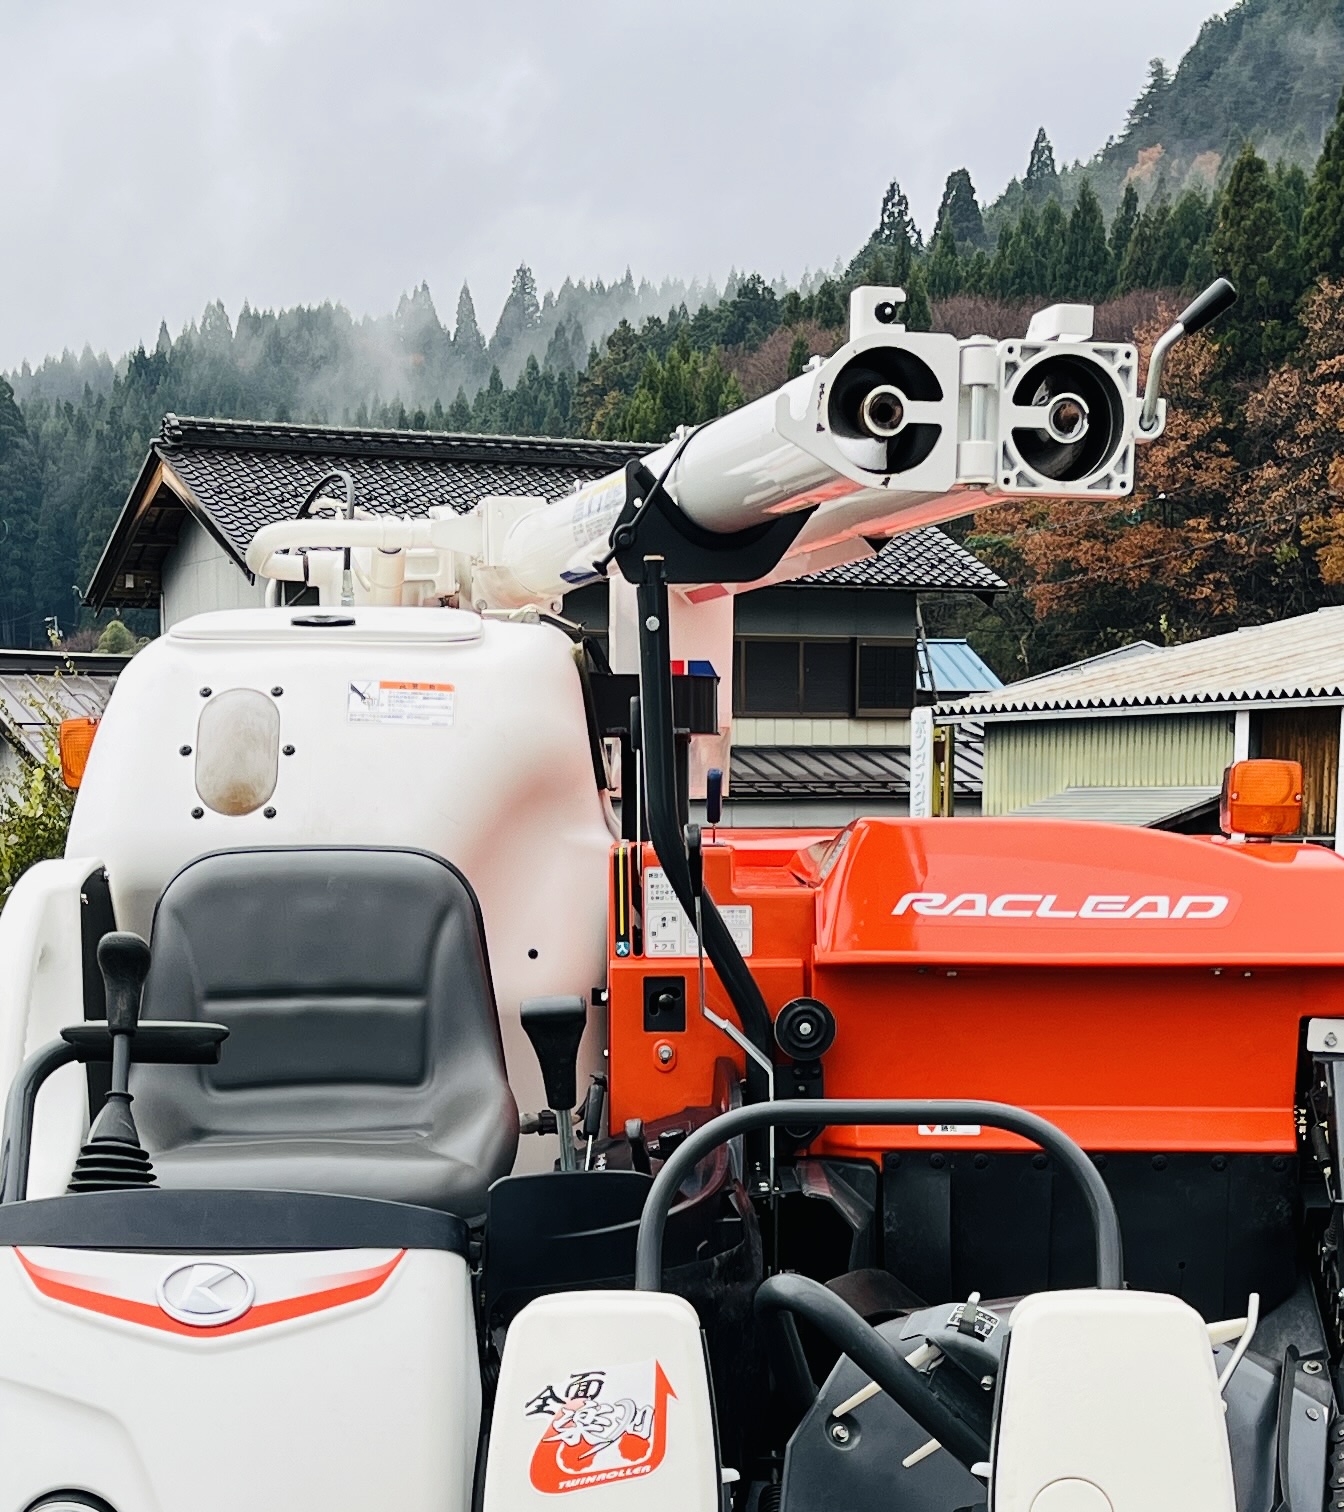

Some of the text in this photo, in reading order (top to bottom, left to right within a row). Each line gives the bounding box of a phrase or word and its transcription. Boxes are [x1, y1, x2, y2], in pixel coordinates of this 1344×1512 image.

[890, 891, 1230, 920] RACLEAD
[524, 1370, 607, 1417] 全面
[557, 1463, 653, 1491] TWINROLLER
